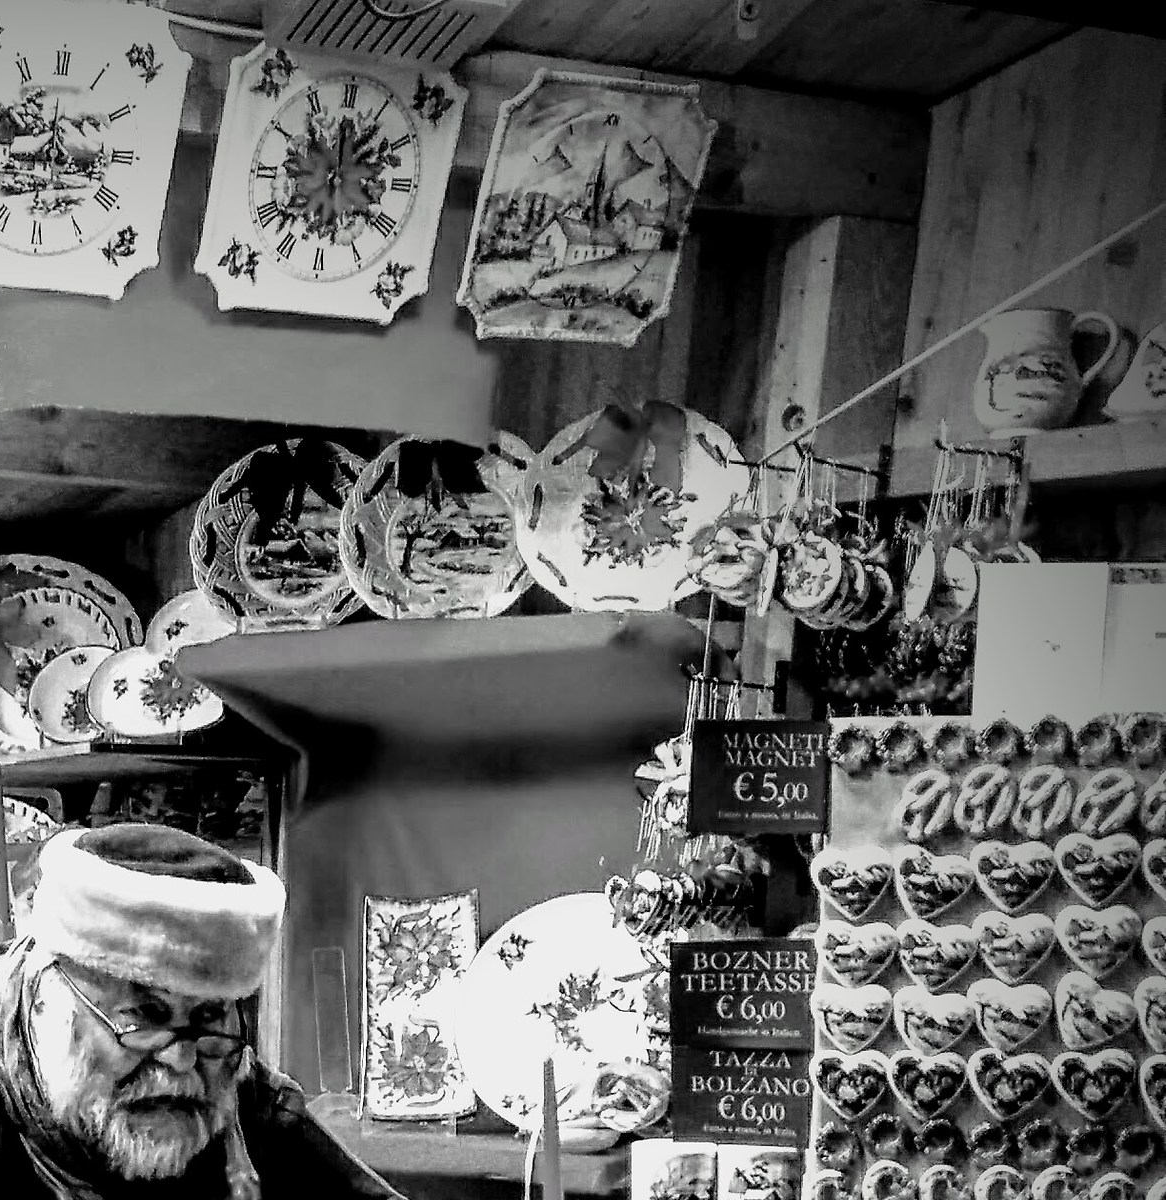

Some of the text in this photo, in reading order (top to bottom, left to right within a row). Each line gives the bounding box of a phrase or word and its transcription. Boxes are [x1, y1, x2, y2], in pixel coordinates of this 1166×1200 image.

[724, 732, 824, 750] MAGNETI
[725, 750, 821, 768] MAGNET
[760, 771, 809, 808] 5,00
[692, 951, 810, 971] BOZNER
[740, 994, 785, 1025] 6,00
[709, 1050, 791, 1067] TAZZA
[691, 1075, 810, 1097] BOLZANO
[741, 1096, 785, 1126] 6,00
